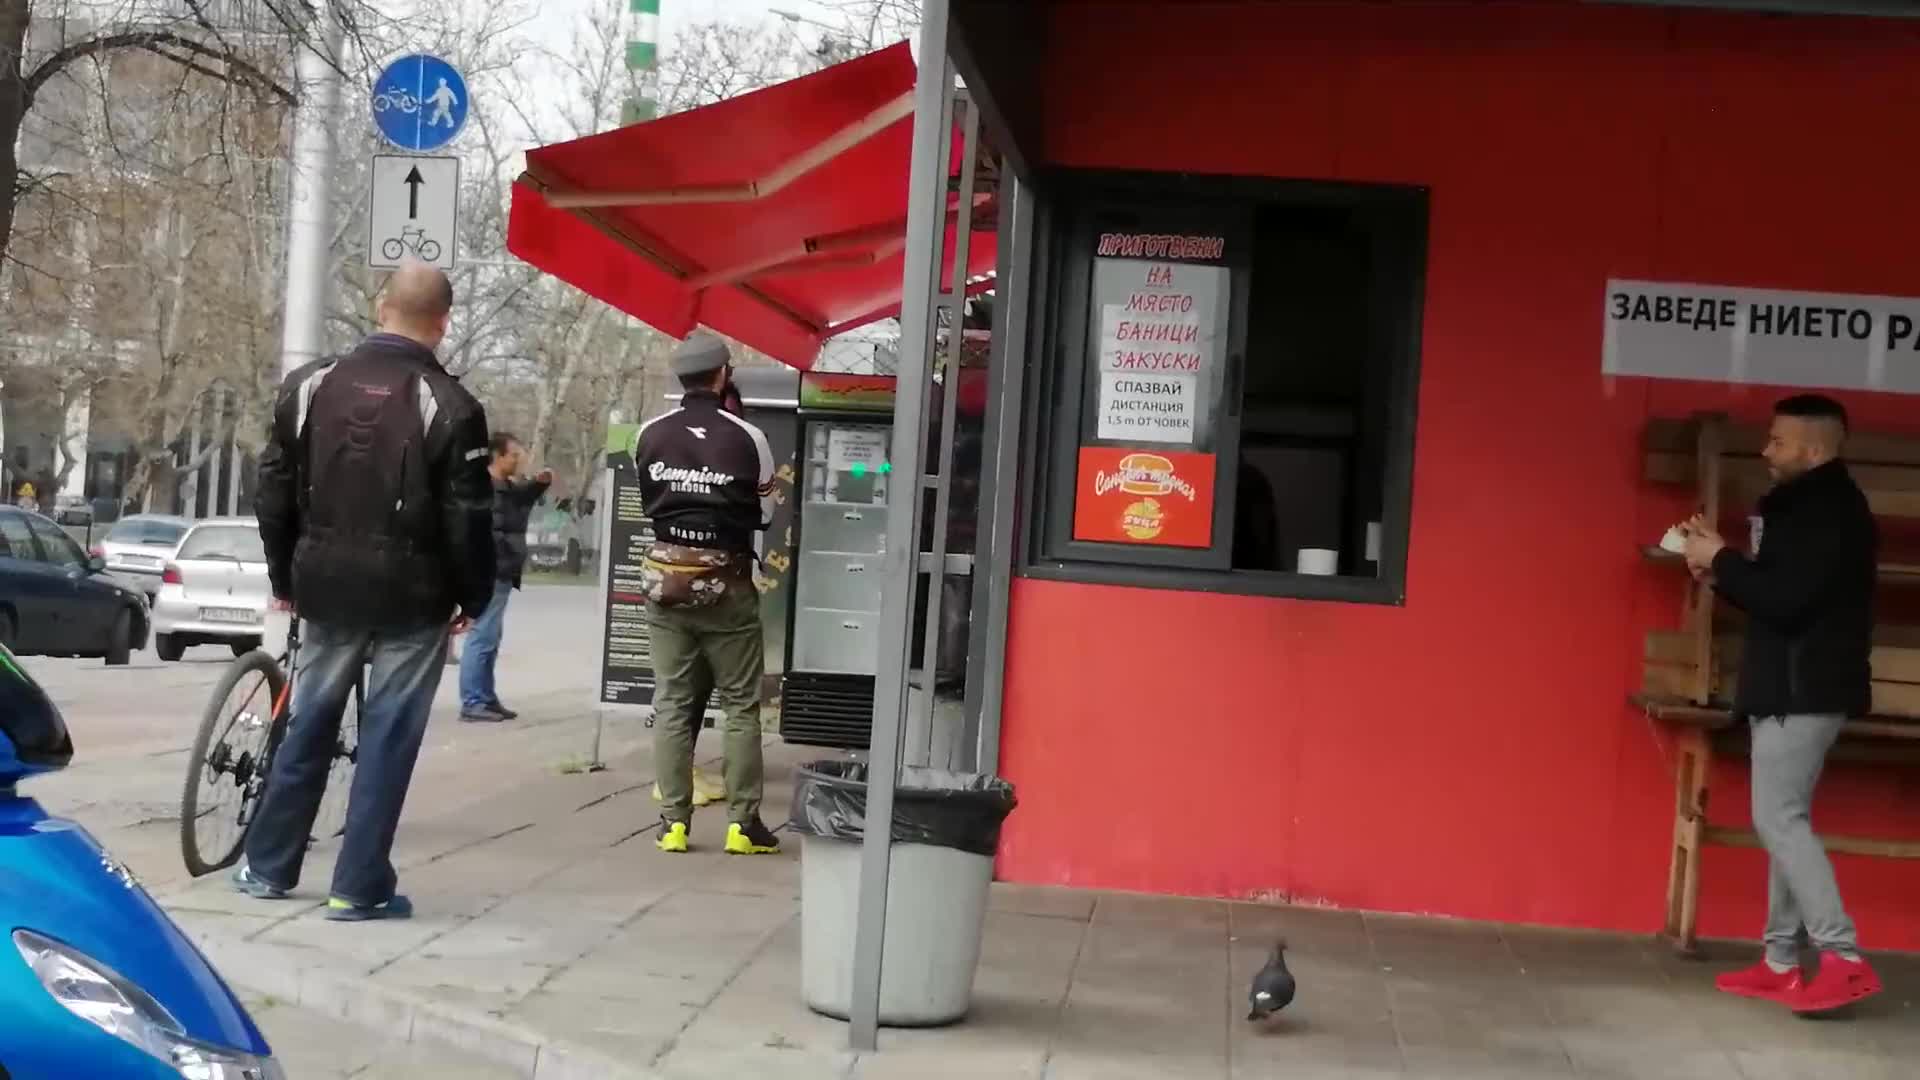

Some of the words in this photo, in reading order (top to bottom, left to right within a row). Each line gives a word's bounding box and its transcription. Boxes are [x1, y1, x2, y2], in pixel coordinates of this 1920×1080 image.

[1097, 233, 1224, 258] ПРИГОТВЕНИ
[1146, 266, 1173, 284] НА
[1124, 294, 1193, 313] МЯСТО
[1611, 293, 1737, 332] ЗАВЕДЕ
[1749, 303, 1873, 341] НИЕТО
[1116, 321, 1199, 344] БАНИЦИ
[1111, 351, 1201, 371] ЗАКУСКИ
[1114, 380, 1182, 396] СПАЗВАЙ
[1110, 399, 1184, 413] ДИСТАНЦИЯ
[1137, 416, 1152, 426] ОТ
[1153, 418, 1190, 429] ЧОВЕК
[671, 481, 711, 494] DIADORA
